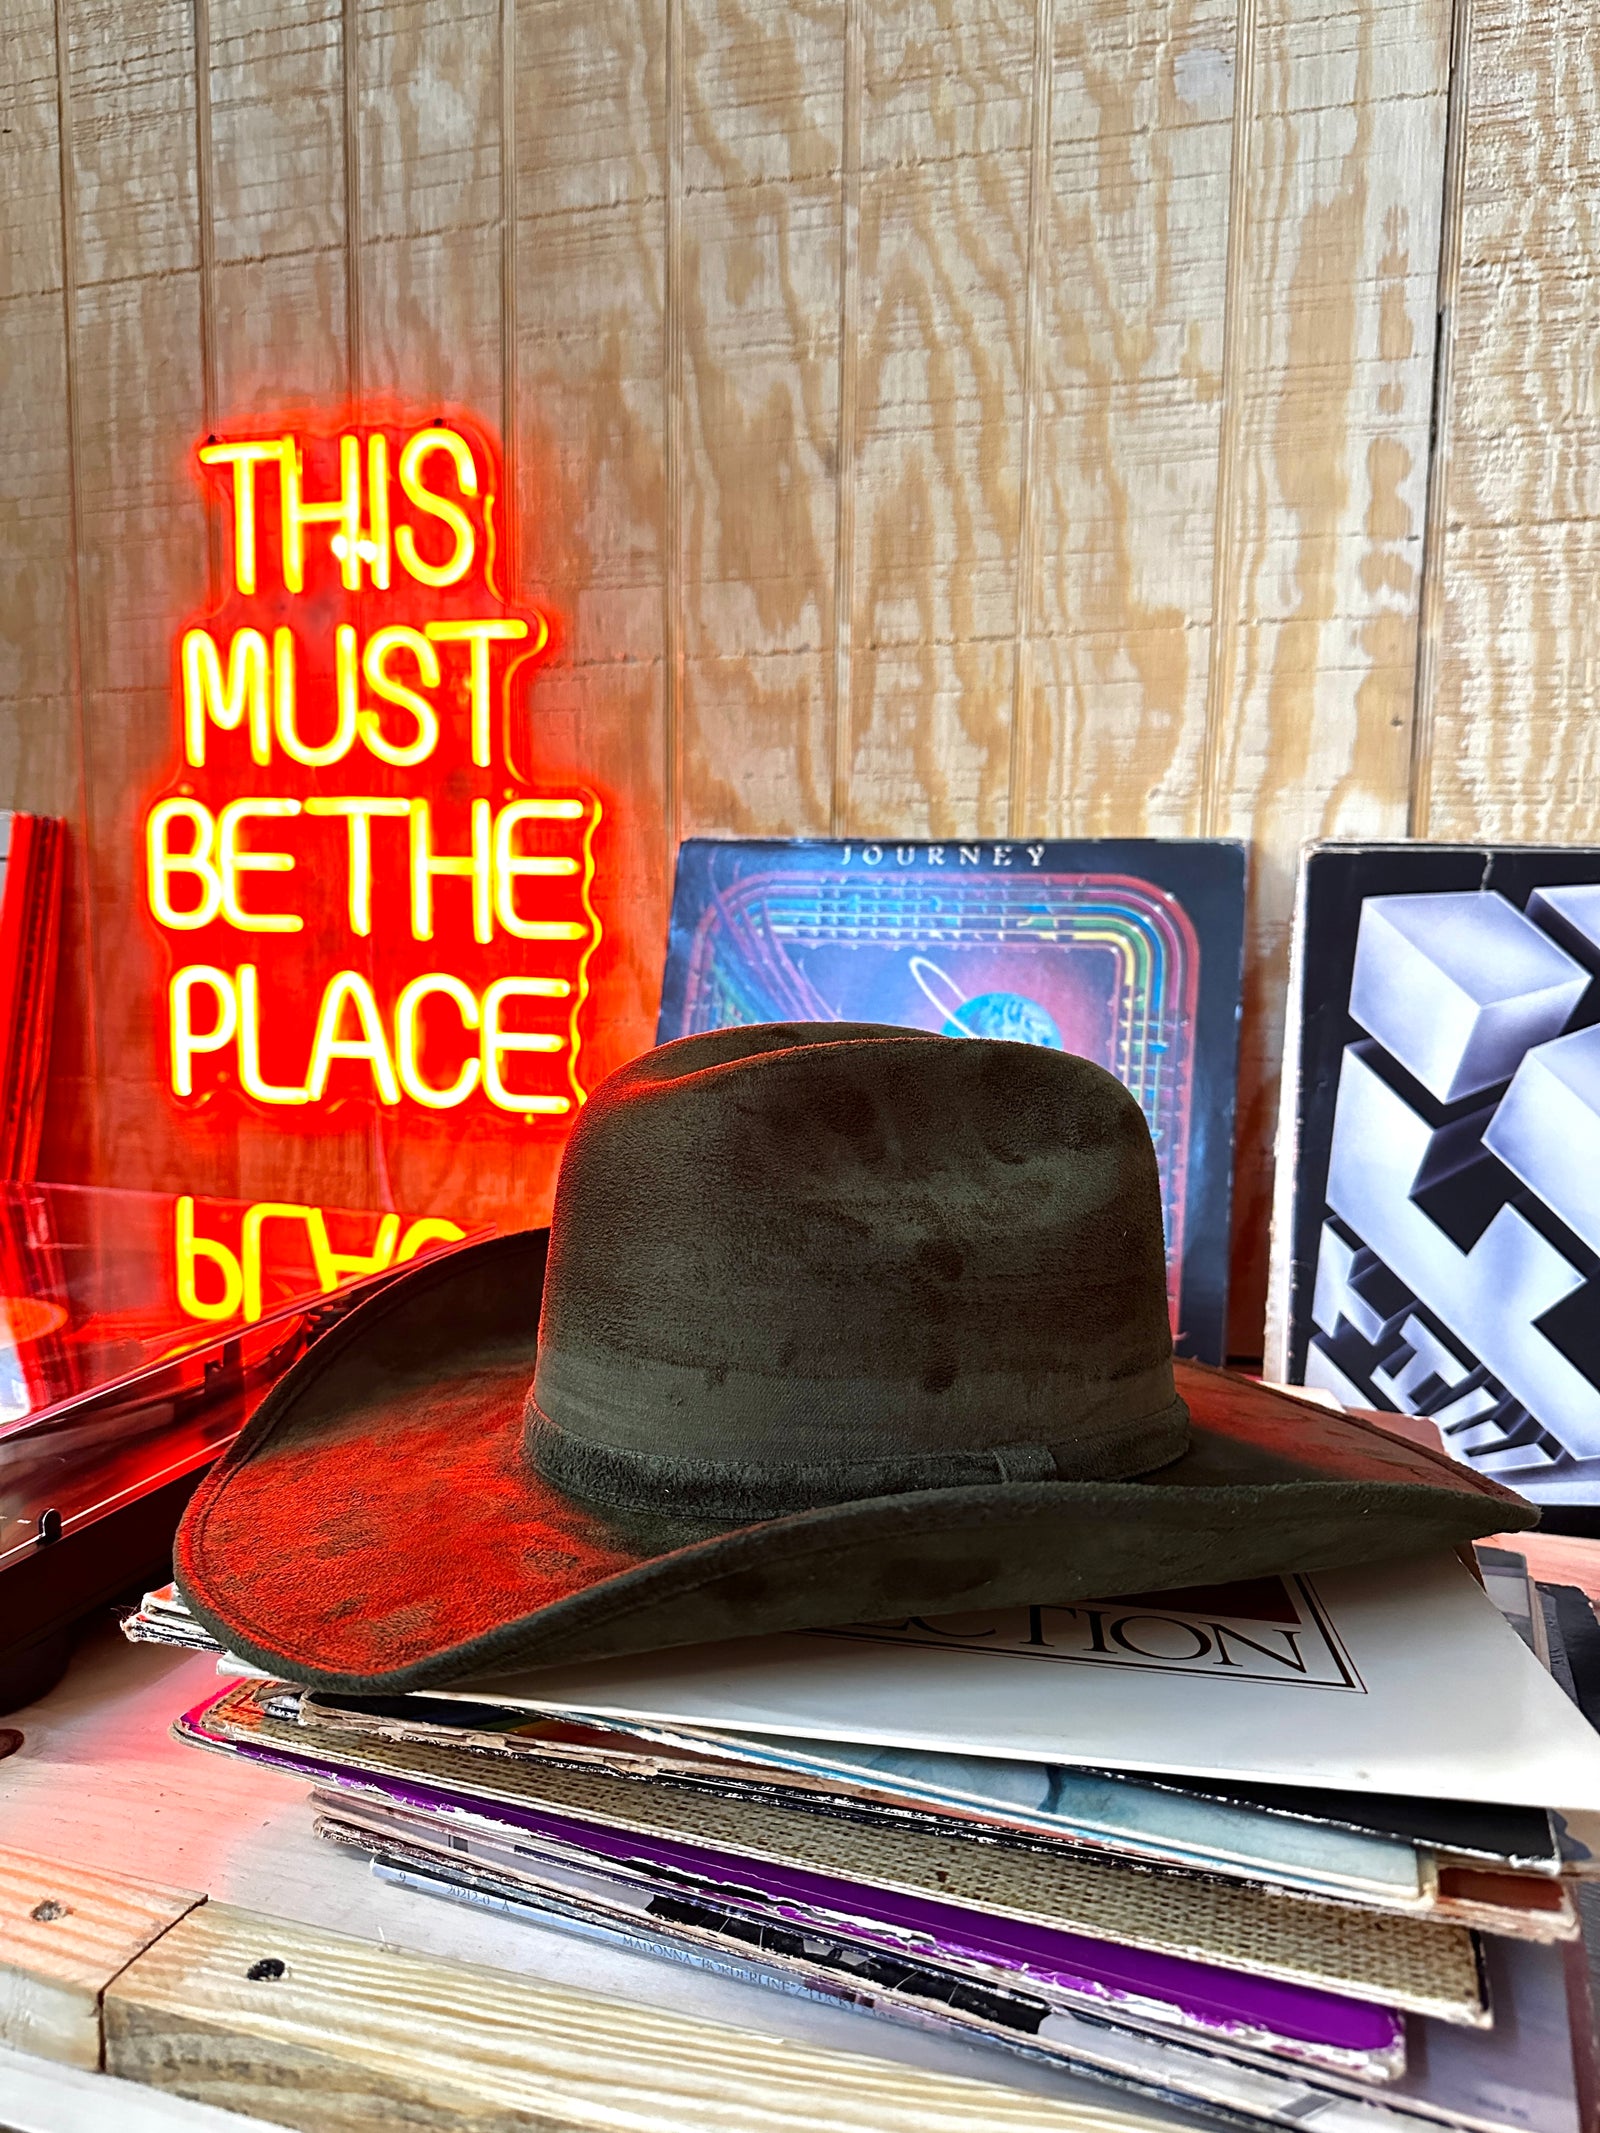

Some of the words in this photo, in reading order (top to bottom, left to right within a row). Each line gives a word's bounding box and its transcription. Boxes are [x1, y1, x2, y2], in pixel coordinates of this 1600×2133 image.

[200, 428, 478, 594] THIS
[182, 619, 529, 768] MUST
[147, 797, 304, 932] BE
[304, 797, 586, 944] THE
[840, 844, 1045, 867] JOURNEY
[170, 964, 571, 1114] PLACE
[622, 1935, 693, 1965] MADONNA
